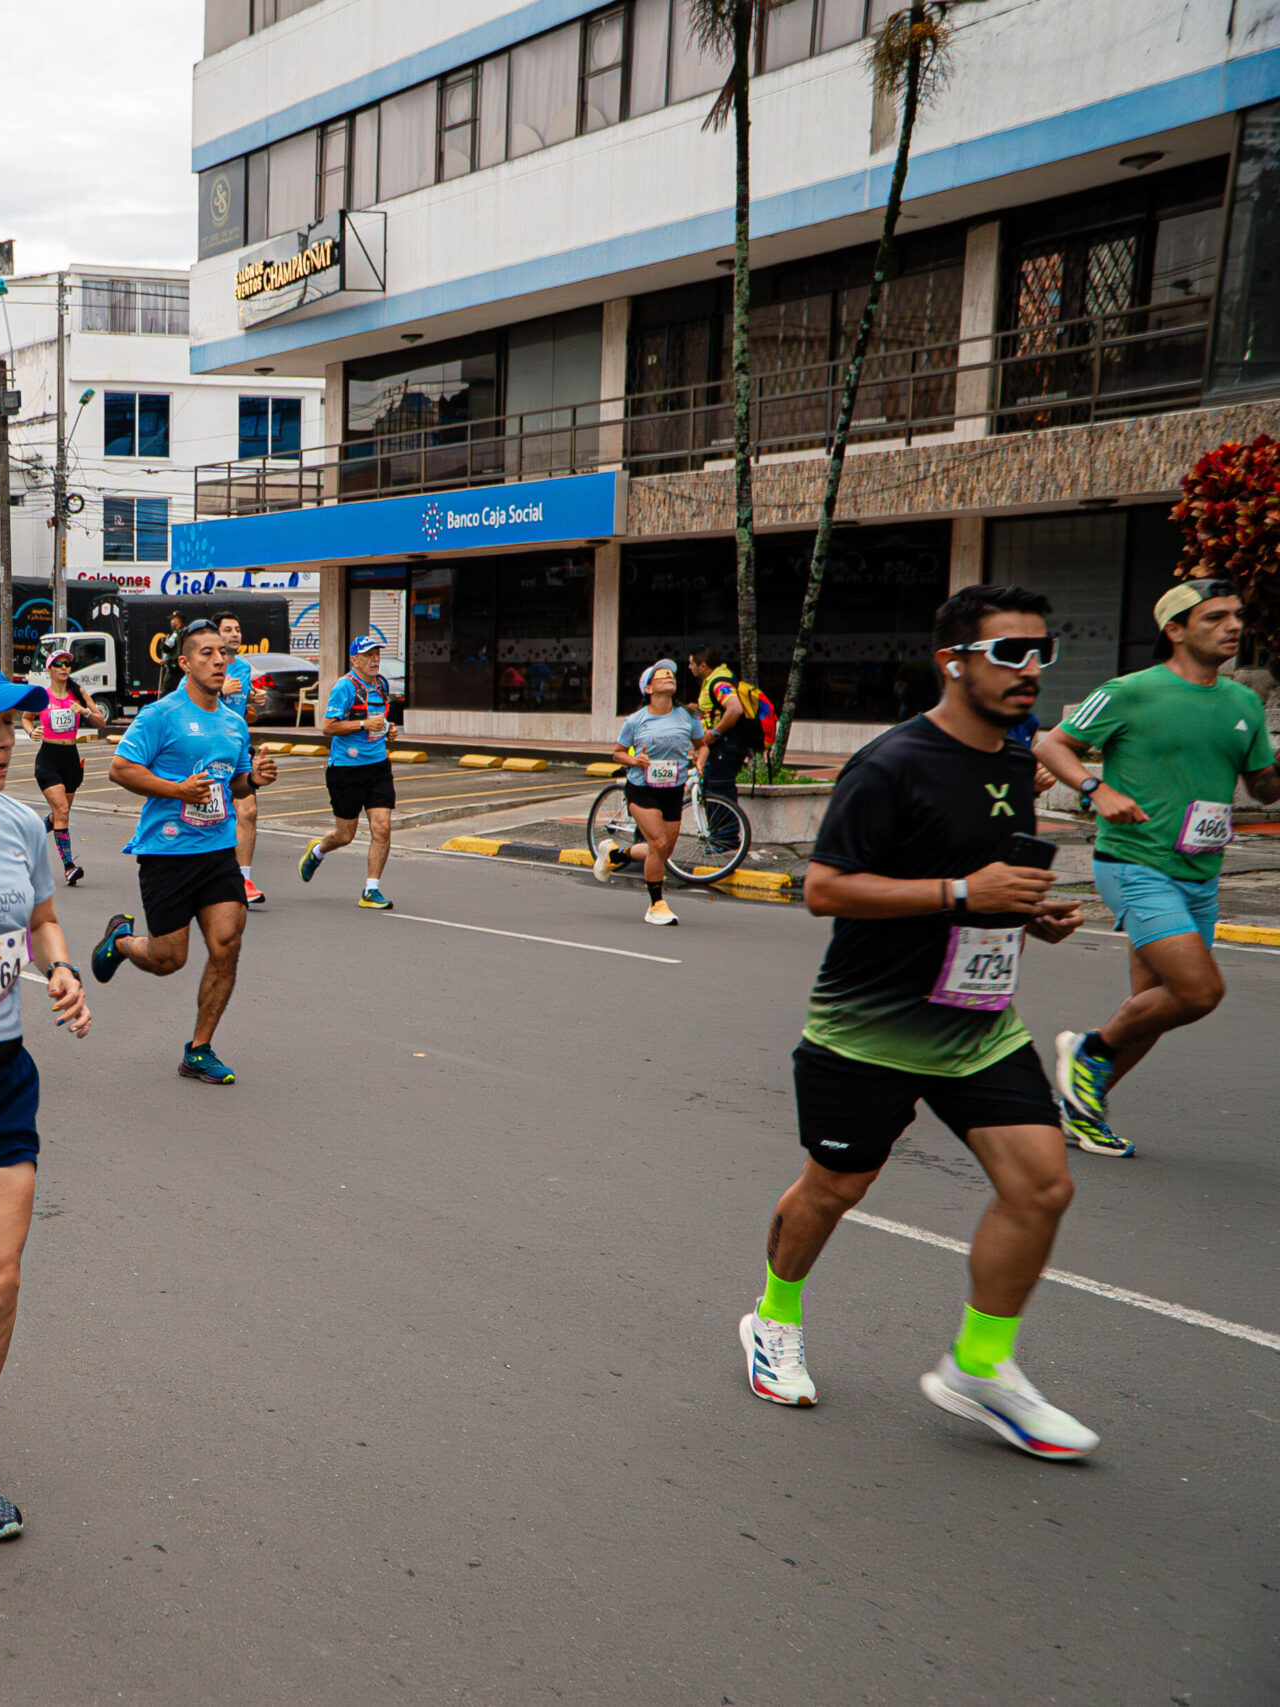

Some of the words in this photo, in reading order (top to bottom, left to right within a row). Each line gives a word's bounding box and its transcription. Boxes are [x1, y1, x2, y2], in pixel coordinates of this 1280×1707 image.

[234, 275, 262, 300] EVENTOS
[447, 510, 480, 530] Banco
[481, 506, 507, 529] Caja
[508, 501, 543, 524] Social
[13, 623, 39, 640] ielo
[291, 631, 320, 650] ielo
[237, 637, 270, 654] zul
[55, 716, 72, 726] 7125
[651, 768, 673, 778] 4528
[964, 953, 1015, 980] 4734
